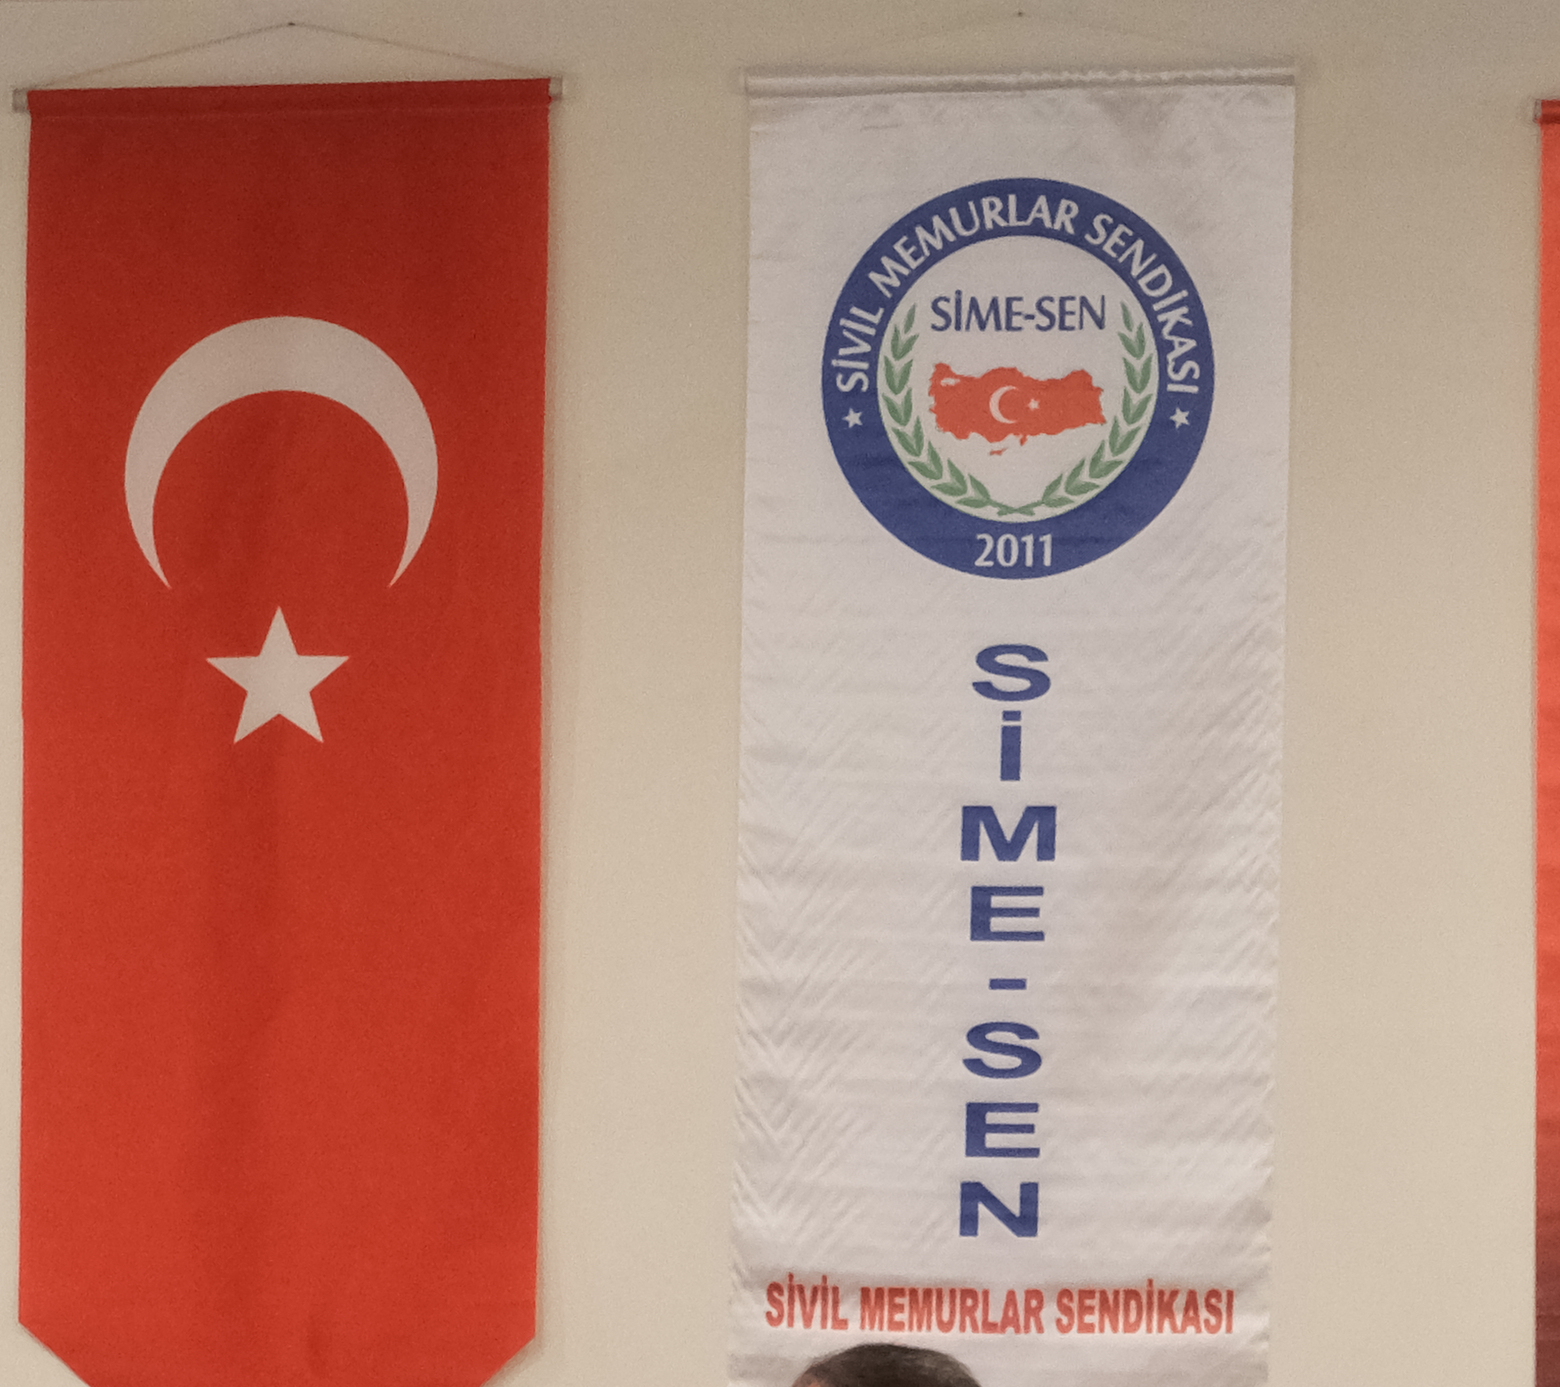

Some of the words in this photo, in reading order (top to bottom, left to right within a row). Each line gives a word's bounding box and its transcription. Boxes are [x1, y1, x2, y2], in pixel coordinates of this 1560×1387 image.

[831, 307, 885, 393] SİVİL
[868, 194, 1080, 298] MEMURLAR
[1084, 213, 1201, 394] SENDİKASI
[931, 290, 1106, 333] SİME-SEN
[974, 533, 1052, 567] 2011
[960, 644, 1057, 1237] SİME-SEN
[765, 1273, 851, 1331] SİVİL
[859, 1286, 1047, 1335] MEMURLAR
[1055, 1279, 1237, 1335] SENDİKASI
